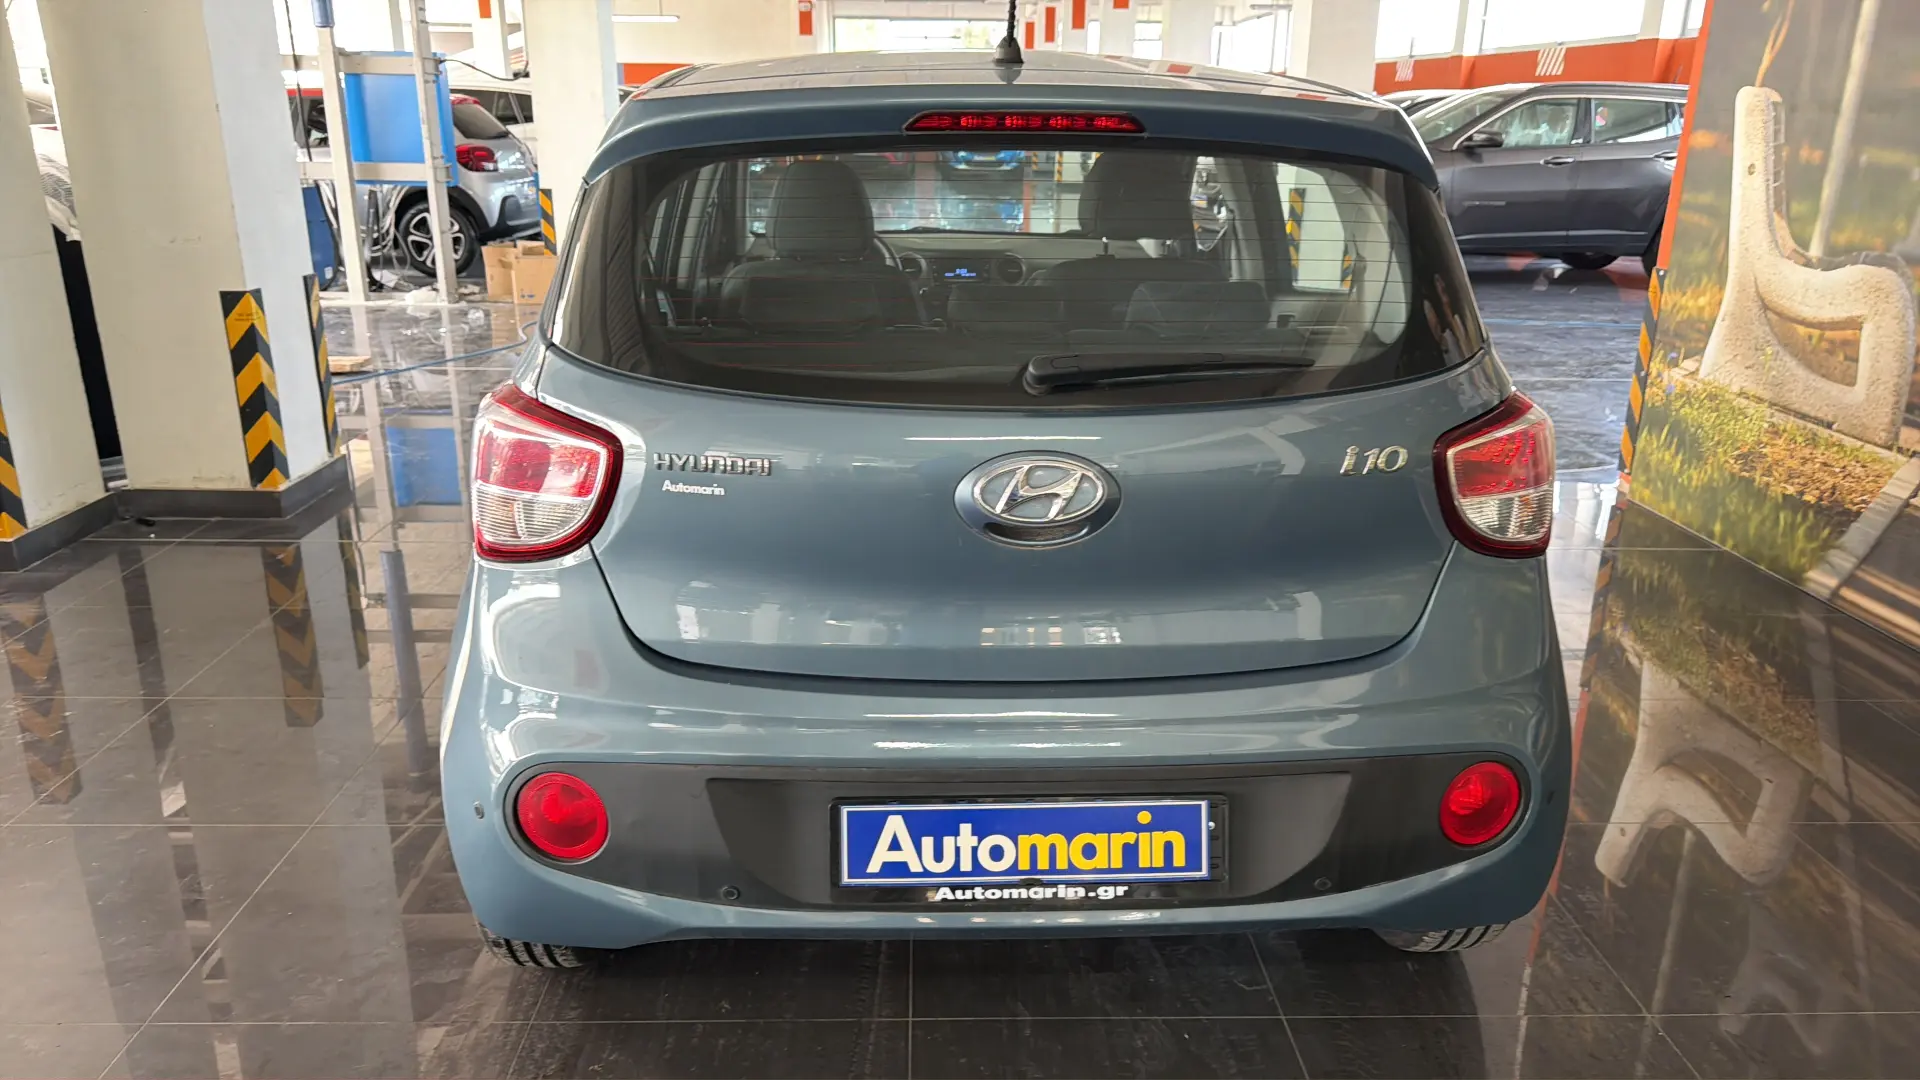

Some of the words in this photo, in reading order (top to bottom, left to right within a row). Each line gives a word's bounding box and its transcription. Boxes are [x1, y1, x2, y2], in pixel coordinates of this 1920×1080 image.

[653, 452, 772, 476] HYUNDAI
[1340, 445, 1408, 476] i10
[662, 480, 725, 496] Automarin
[866, 811, 1186, 874] Automarin
[934, 885, 1129, 902] Automarin.gr
